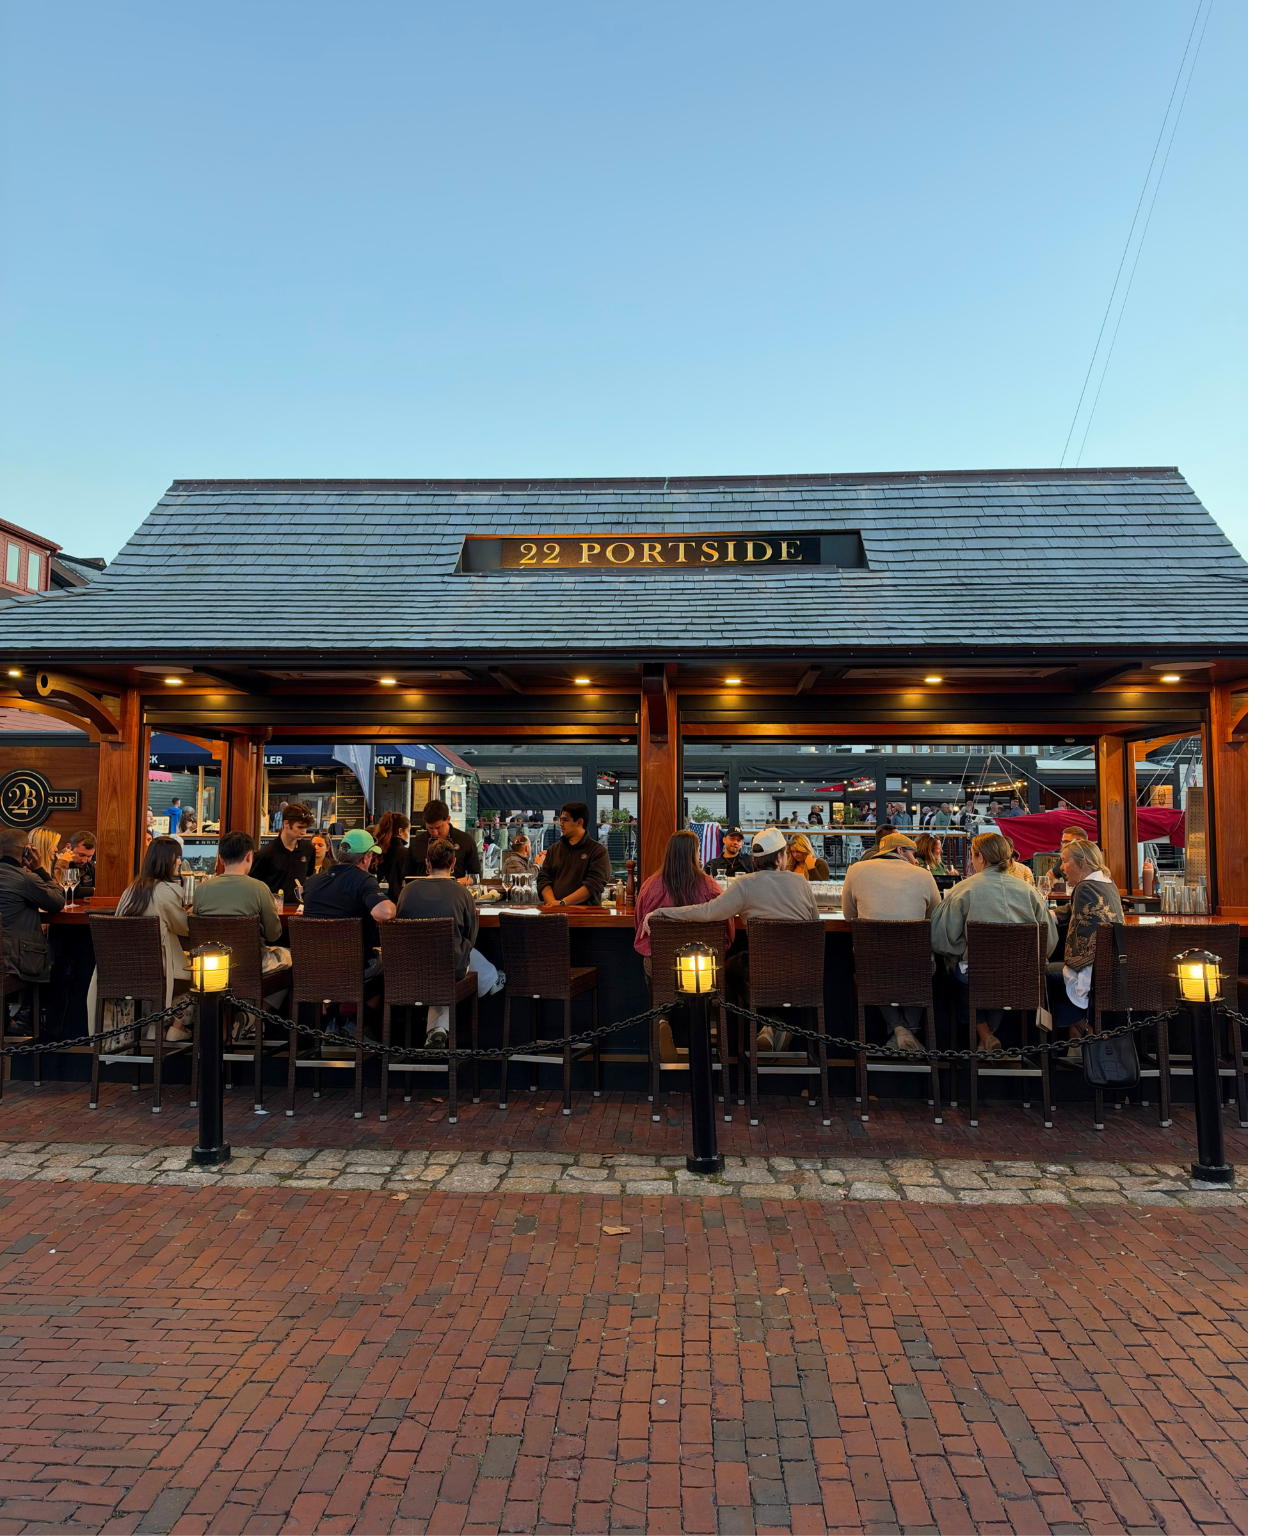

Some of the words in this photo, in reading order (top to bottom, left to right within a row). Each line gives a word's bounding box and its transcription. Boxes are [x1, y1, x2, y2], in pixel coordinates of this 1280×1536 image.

[519, 543, 561, 564] 22
[579, 540, 803, 563] PORTSIDE
[47, 796, 76, 804] SIDE
